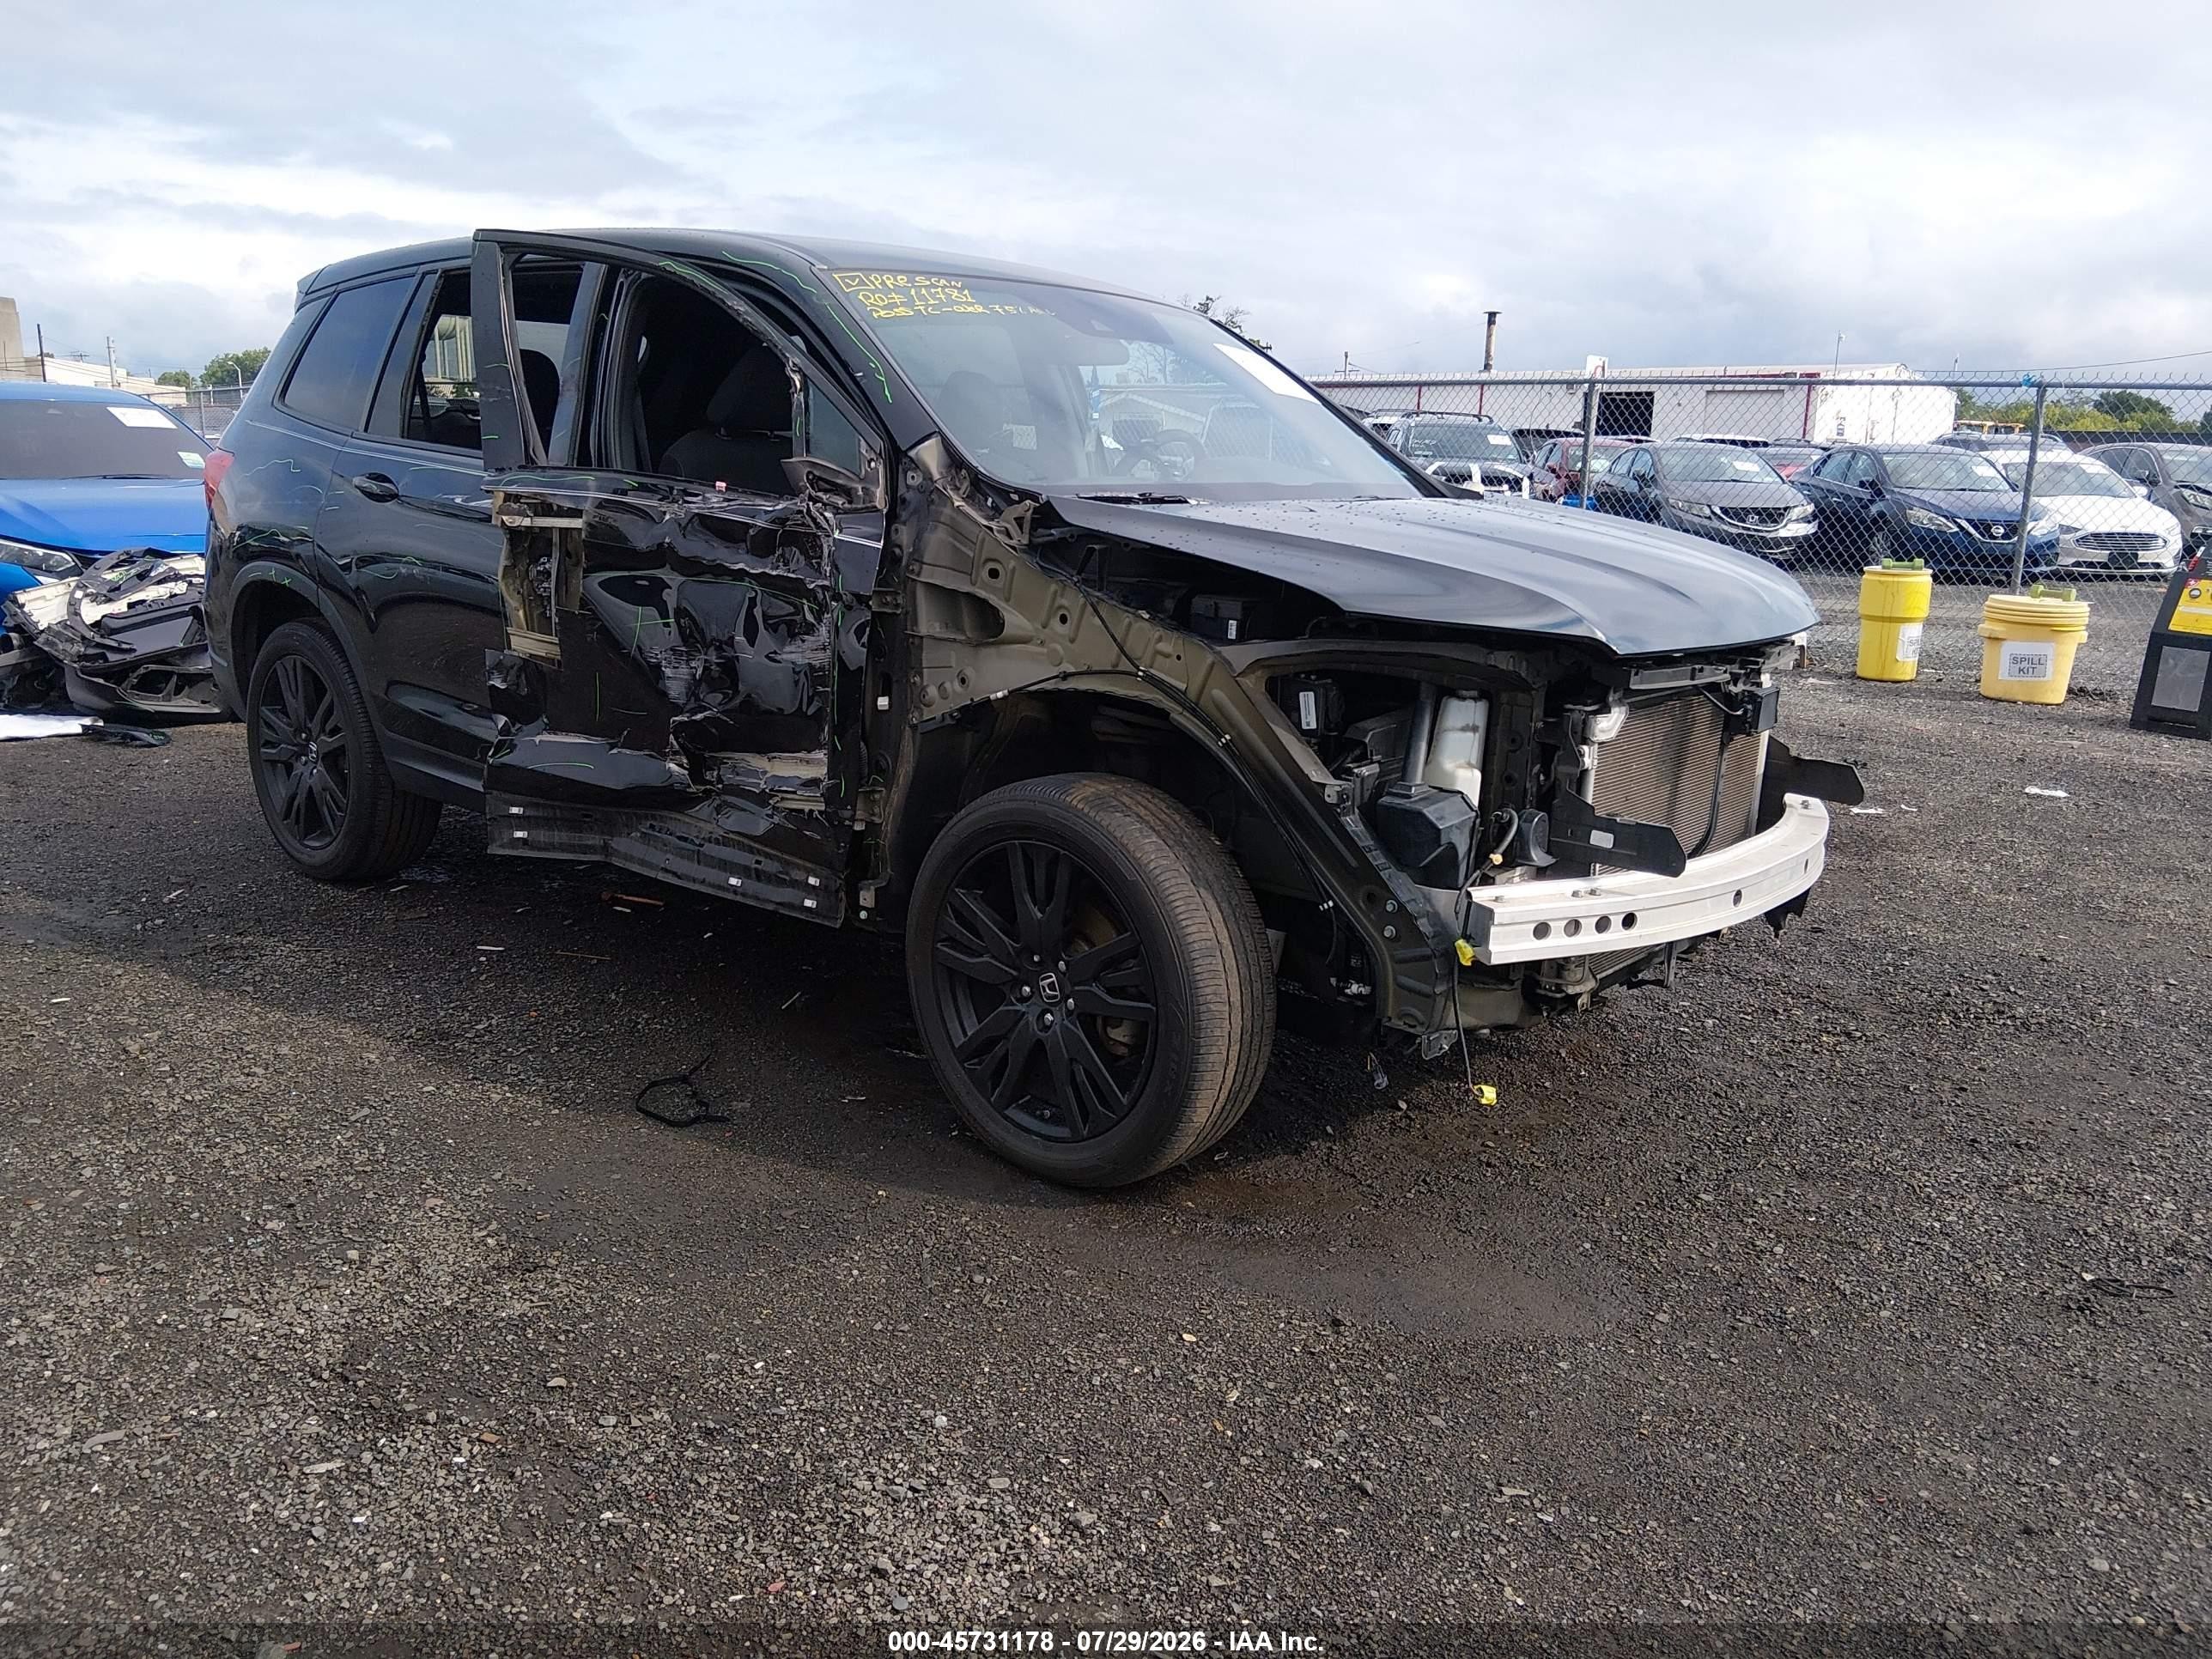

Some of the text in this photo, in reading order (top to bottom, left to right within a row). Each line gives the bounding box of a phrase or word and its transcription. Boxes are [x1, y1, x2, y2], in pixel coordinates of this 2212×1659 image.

[913, 275, 963, 289] SCAN
[909, 288, 976, 306] 11781
[2012, 656, 2045, 665] SPILL
[2018, 665, 2038, 676] KIT
